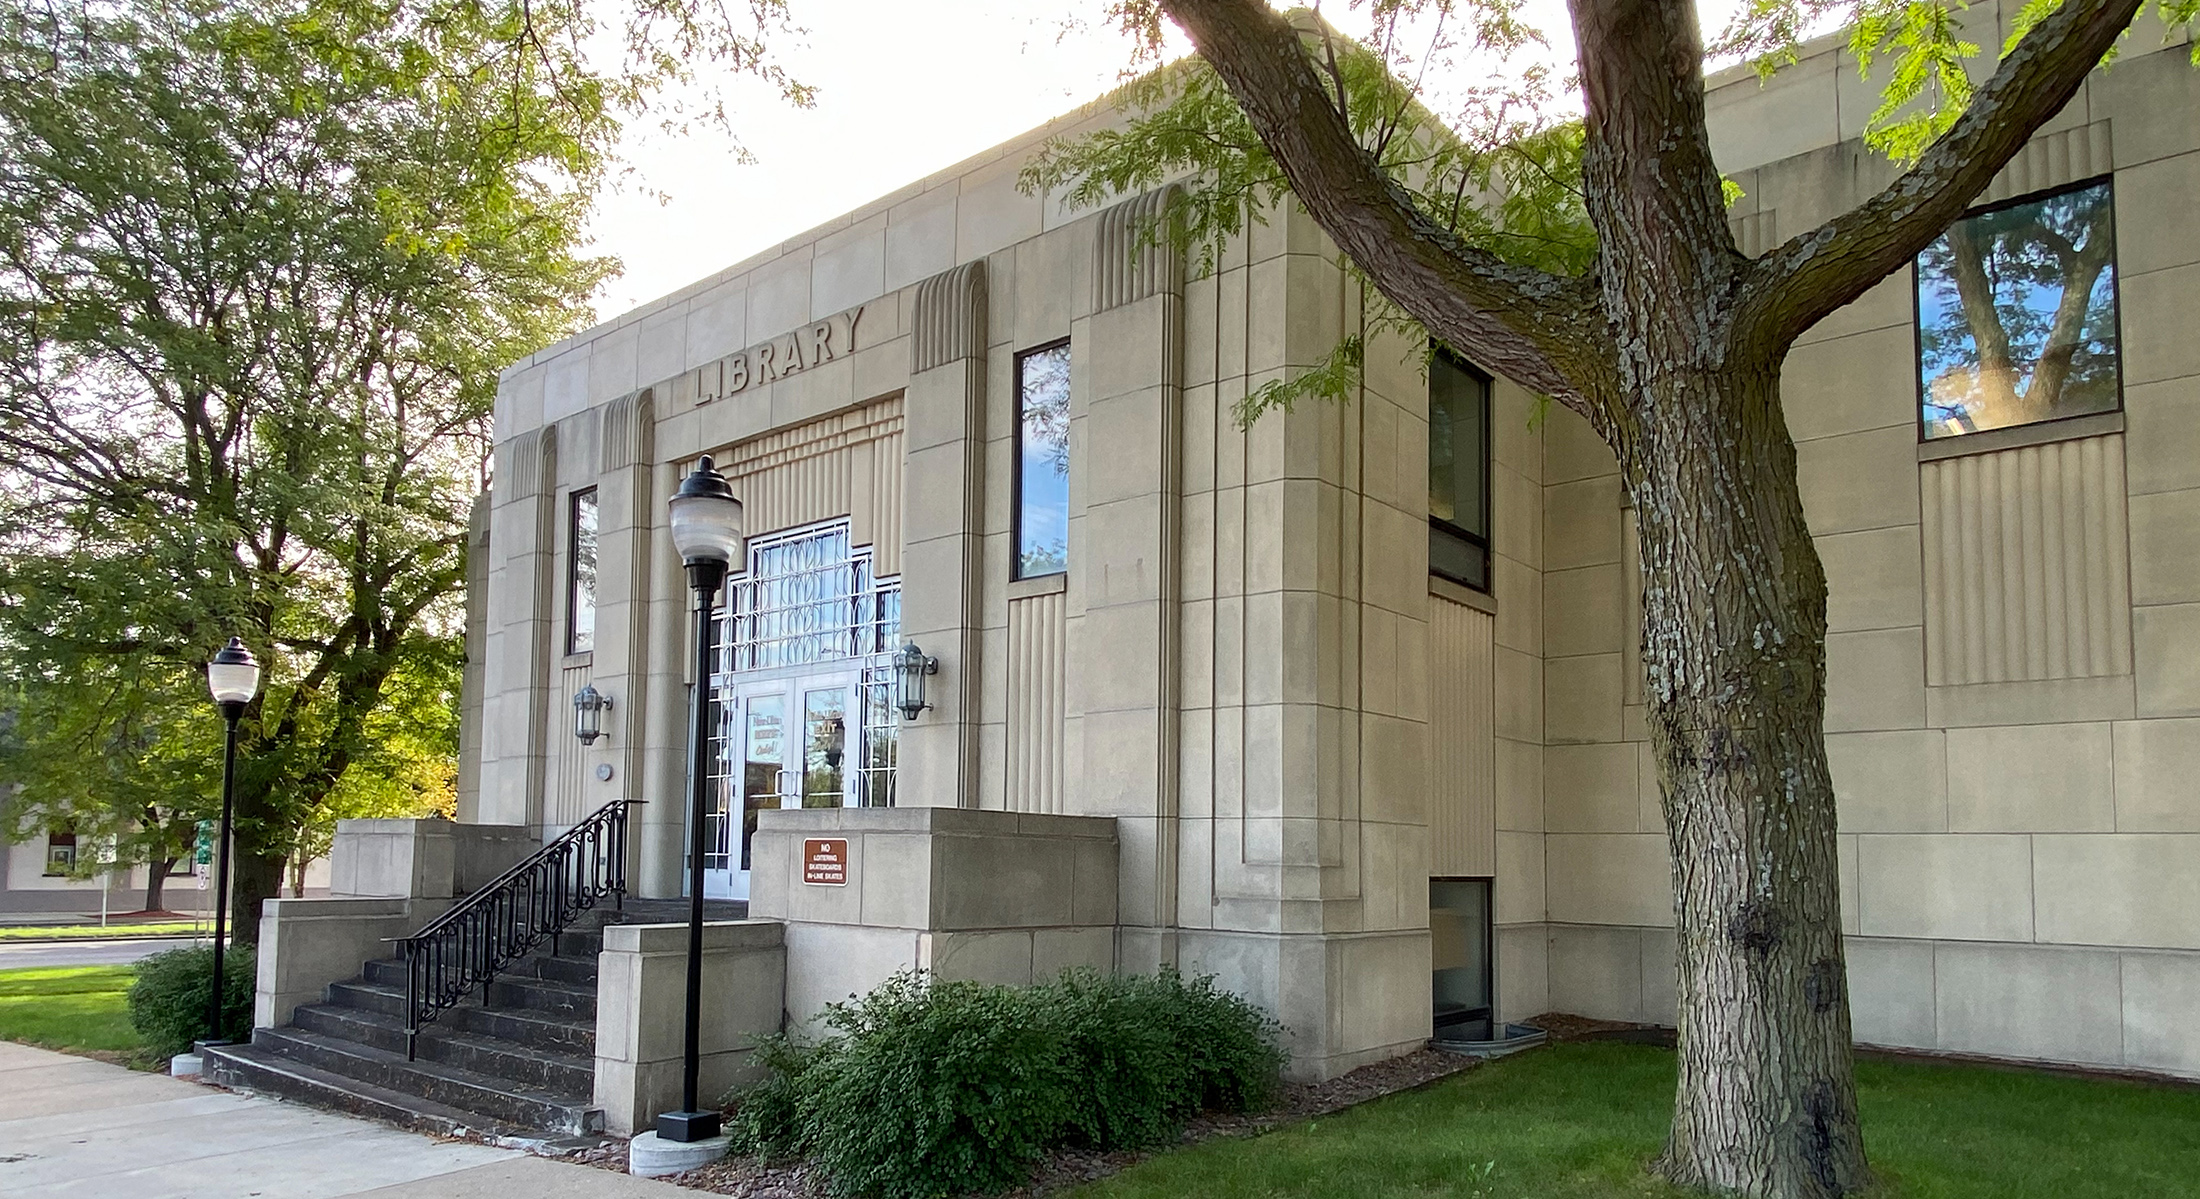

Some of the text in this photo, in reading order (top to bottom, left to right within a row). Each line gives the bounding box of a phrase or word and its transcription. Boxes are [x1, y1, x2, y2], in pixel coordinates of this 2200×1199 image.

[694, 306, 864, 407] LIBRARY
[814, 722, 837, 734] EXIT
[820, 843, 831, 852] NO
